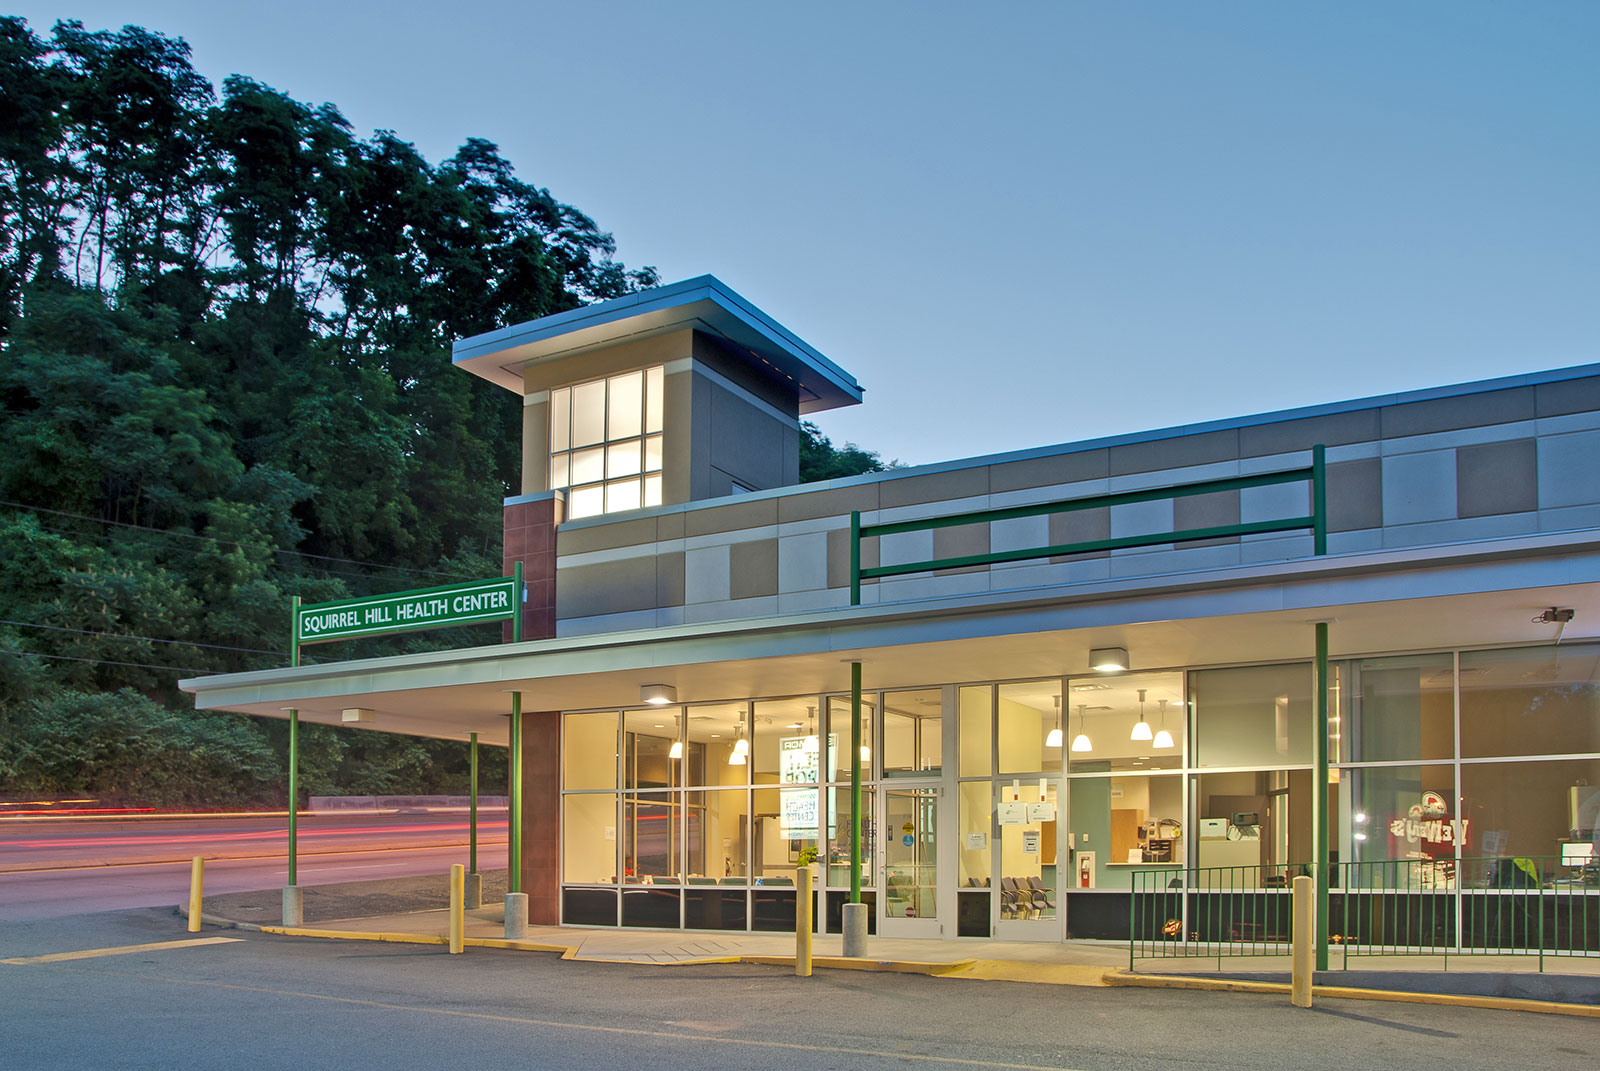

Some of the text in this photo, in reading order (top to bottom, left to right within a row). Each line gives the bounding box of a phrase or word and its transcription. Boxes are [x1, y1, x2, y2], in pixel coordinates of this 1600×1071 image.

[304, 590, 508, 632] SQUIRREL HILL HEALTH CENTER
